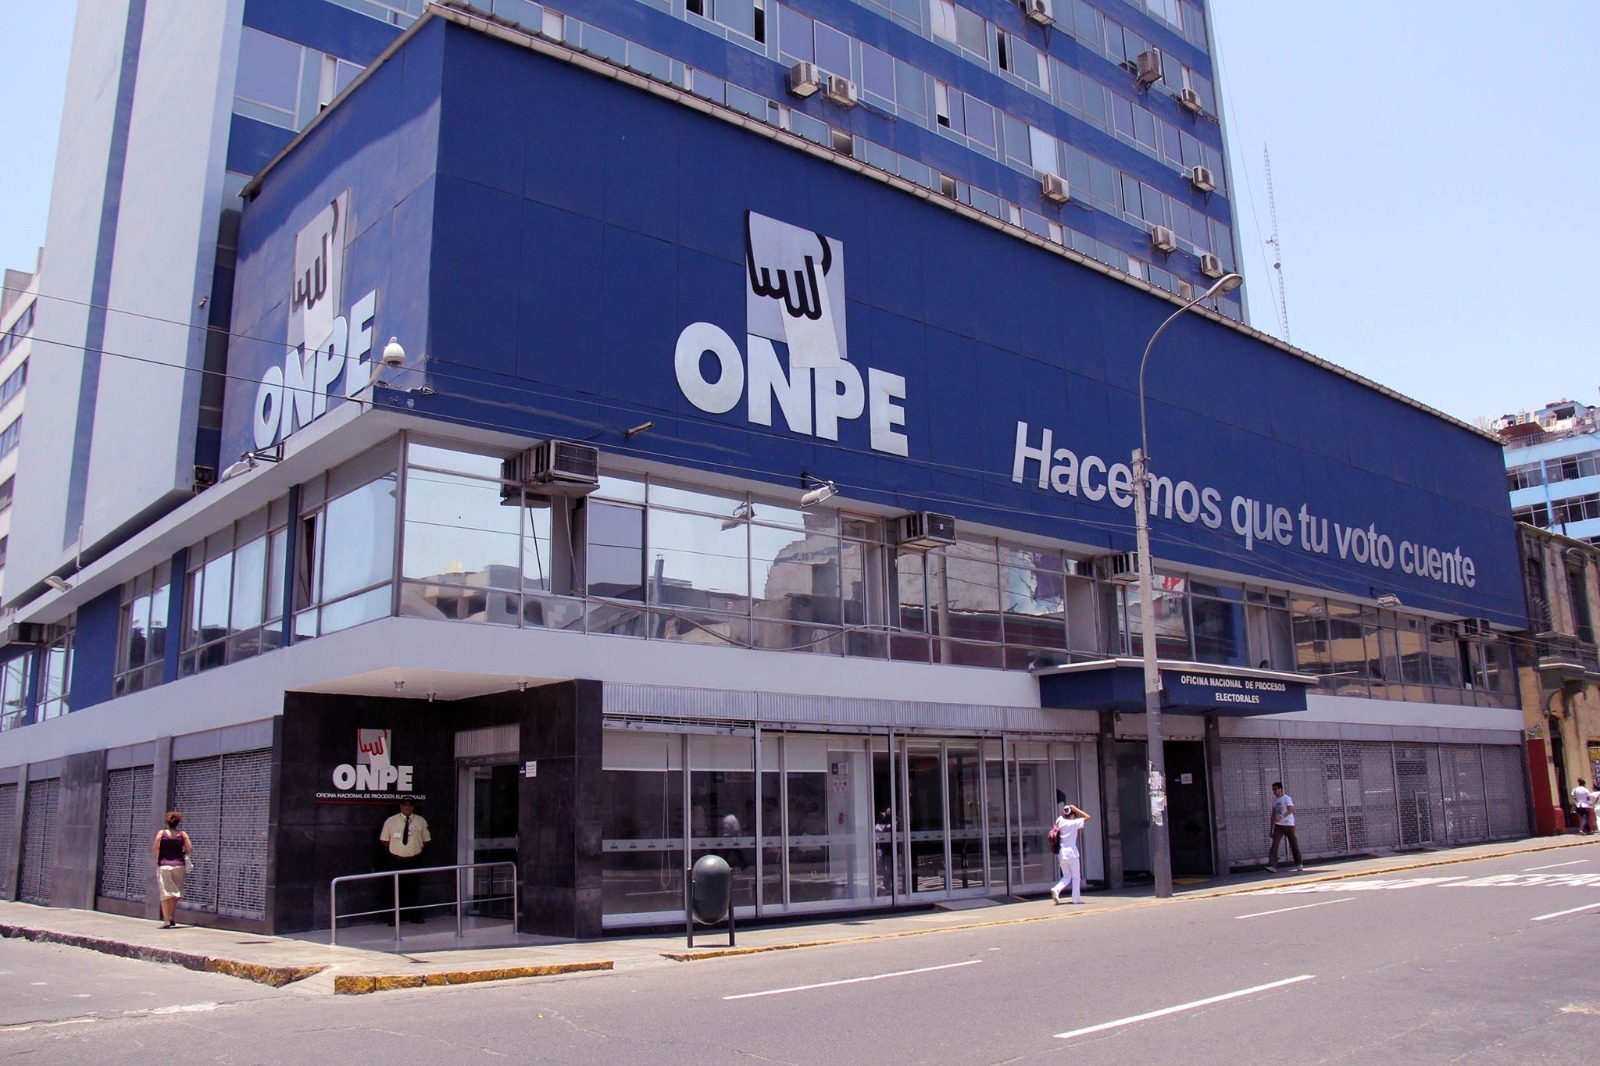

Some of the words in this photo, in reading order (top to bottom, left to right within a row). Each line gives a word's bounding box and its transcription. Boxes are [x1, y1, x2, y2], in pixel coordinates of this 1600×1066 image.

[253, 289, 376, 450] ONPE
[674, 321, 909, 457] ONPE
[1012, 420, 1223, 529] Hacemos
[1230, 495, 1293, 551] que
[1298, 503, 1328, 554] tu
[1333, 522, 1395, 570] voto
[1399, 540, 1476, 588] cuente
[1180, 675, 1209, 686] OFICINA
[1209, 677, 1243, 689] NACIONAL
[1244, 680, 1254, 690] DE
[1254, 681, 1287, 692] PROCESOS
[1215, 692, 1260, 704] ELECTORALES
[332, 763, 414, 792] ONPE
